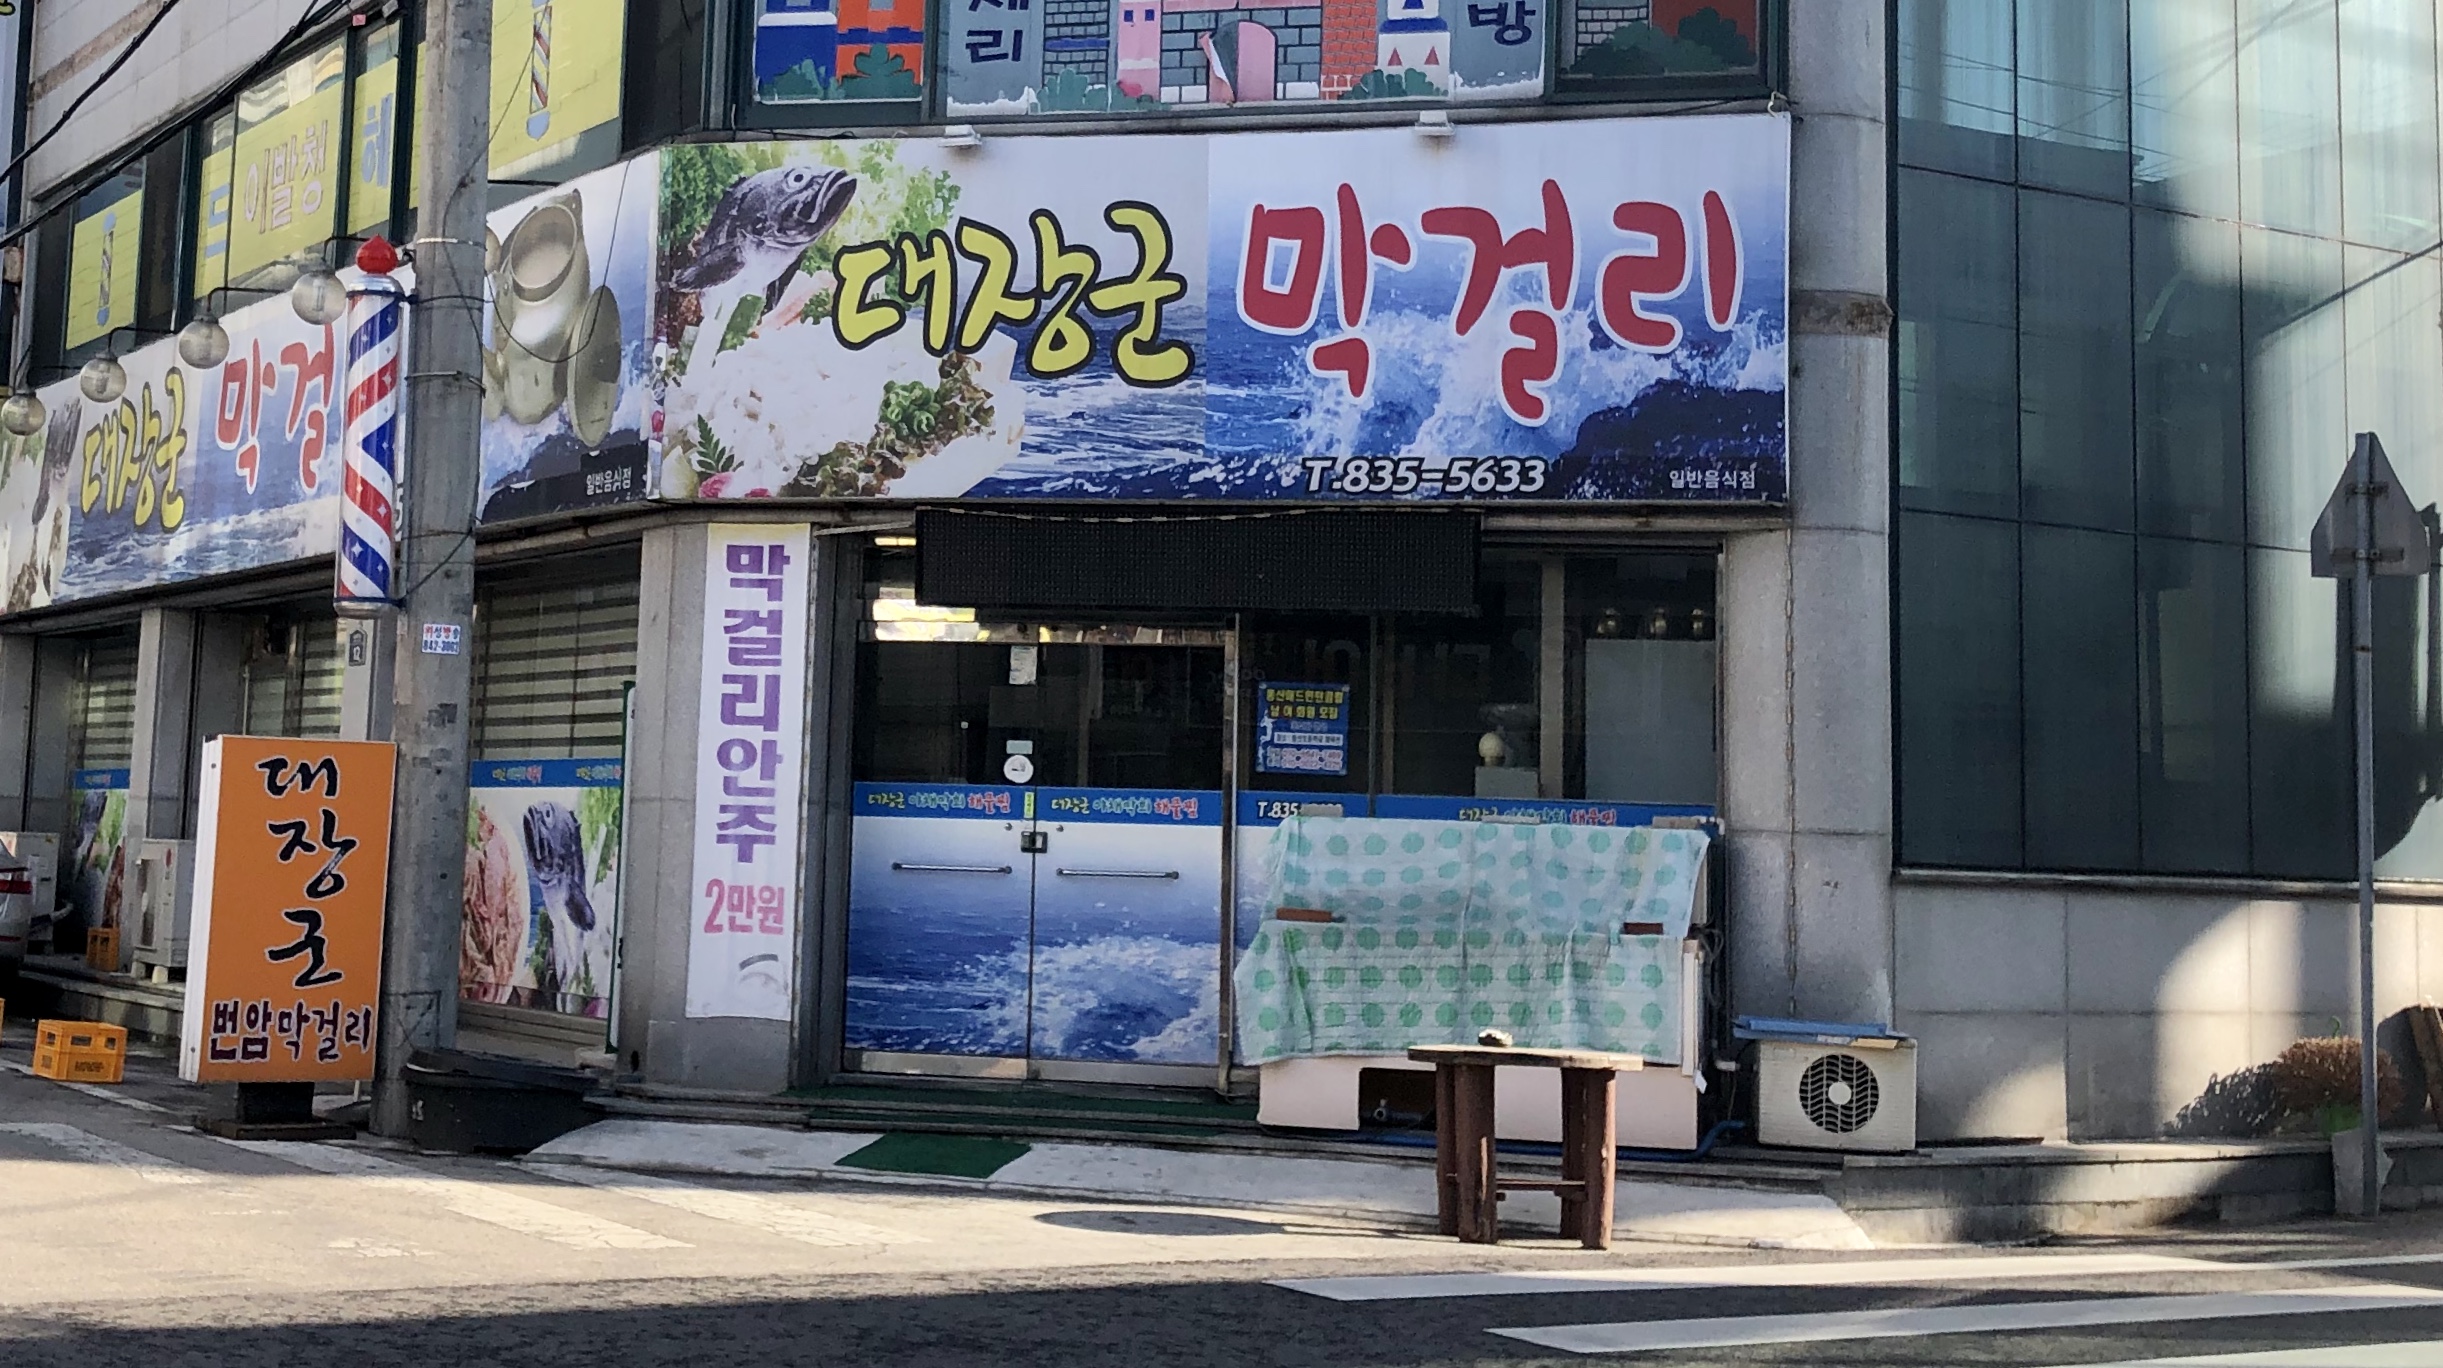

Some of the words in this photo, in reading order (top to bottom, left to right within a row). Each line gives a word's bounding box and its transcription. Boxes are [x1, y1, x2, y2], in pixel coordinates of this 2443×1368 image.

[832, 200, 1196, 388] 대장군
[1237, 178, 1743, 426] 막걸리
[80, 366, 188, 533] 대장군
[586, 465, 631, 496] 일반음식점
[1304, 455, 1547, 495] T.835-5633
[1669, 467, 1756, 490] 일반음식점
[715, 544, 790, 863] 막걸리안주
[254, 756, 359, 988] 대장군
[703, 878, 785, 935] 2만원
[209, 998, 373, 1064] 번암막걸리
